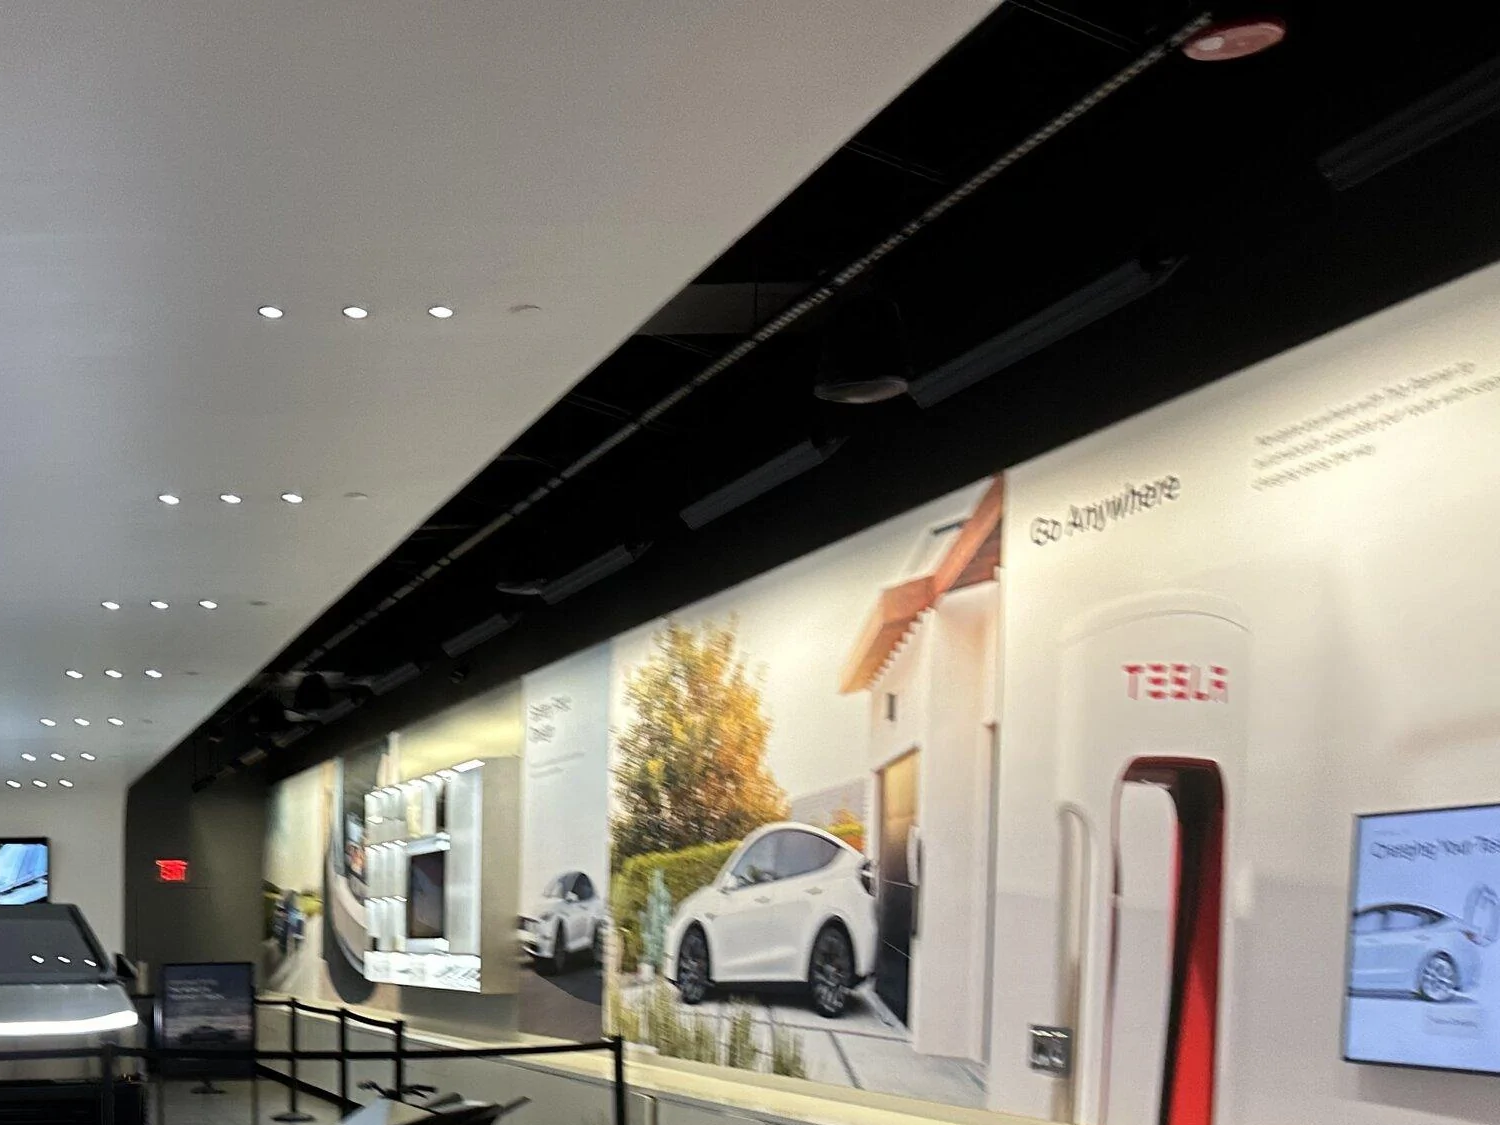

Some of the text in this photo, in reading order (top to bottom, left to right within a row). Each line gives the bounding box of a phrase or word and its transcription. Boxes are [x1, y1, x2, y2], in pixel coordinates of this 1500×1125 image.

[1030, 475, 1181, 546] Go Anywhere
[1121, 663, 1229, 704] TESLA
